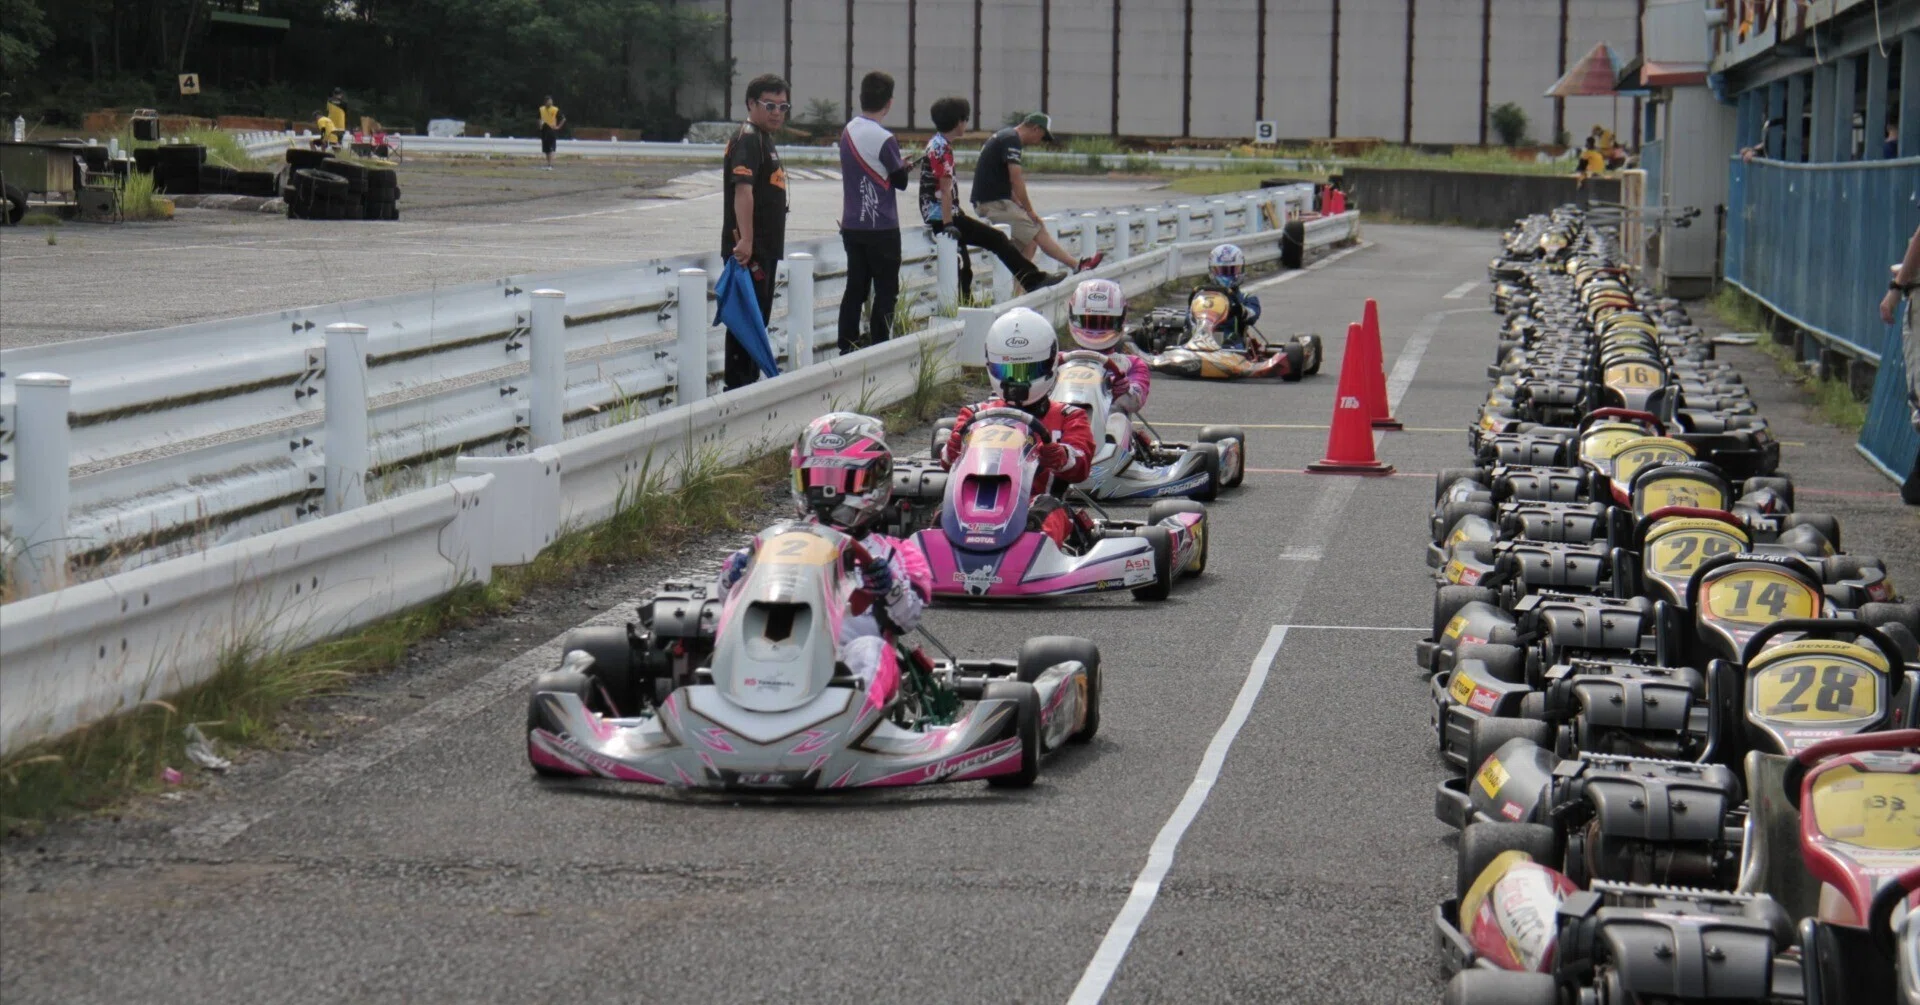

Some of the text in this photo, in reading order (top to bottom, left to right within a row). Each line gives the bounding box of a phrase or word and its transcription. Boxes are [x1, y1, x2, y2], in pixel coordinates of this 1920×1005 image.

[183, 75, 195, 88] 4
[1260, 124, 1272, 138] 9
[1203, 296, 1214, 309] 5
[1009, 337, 1026, 345] Arai
[1622, 366, 1649, 384] 16
[819, 436, 842, 445] Arai
[981, 429, 1014, 442] 21
[966, 536, 995, 544] MOTUL
[776, 539, 808, 556] 2
[1662, 536, 1731, 571] 29
[1125, 559, 1150, 569] Ash
[954, 572, 966, 581] RS
[1725, 580, 1788, 617] 14
[1770, 665, 1858, 714] 28
